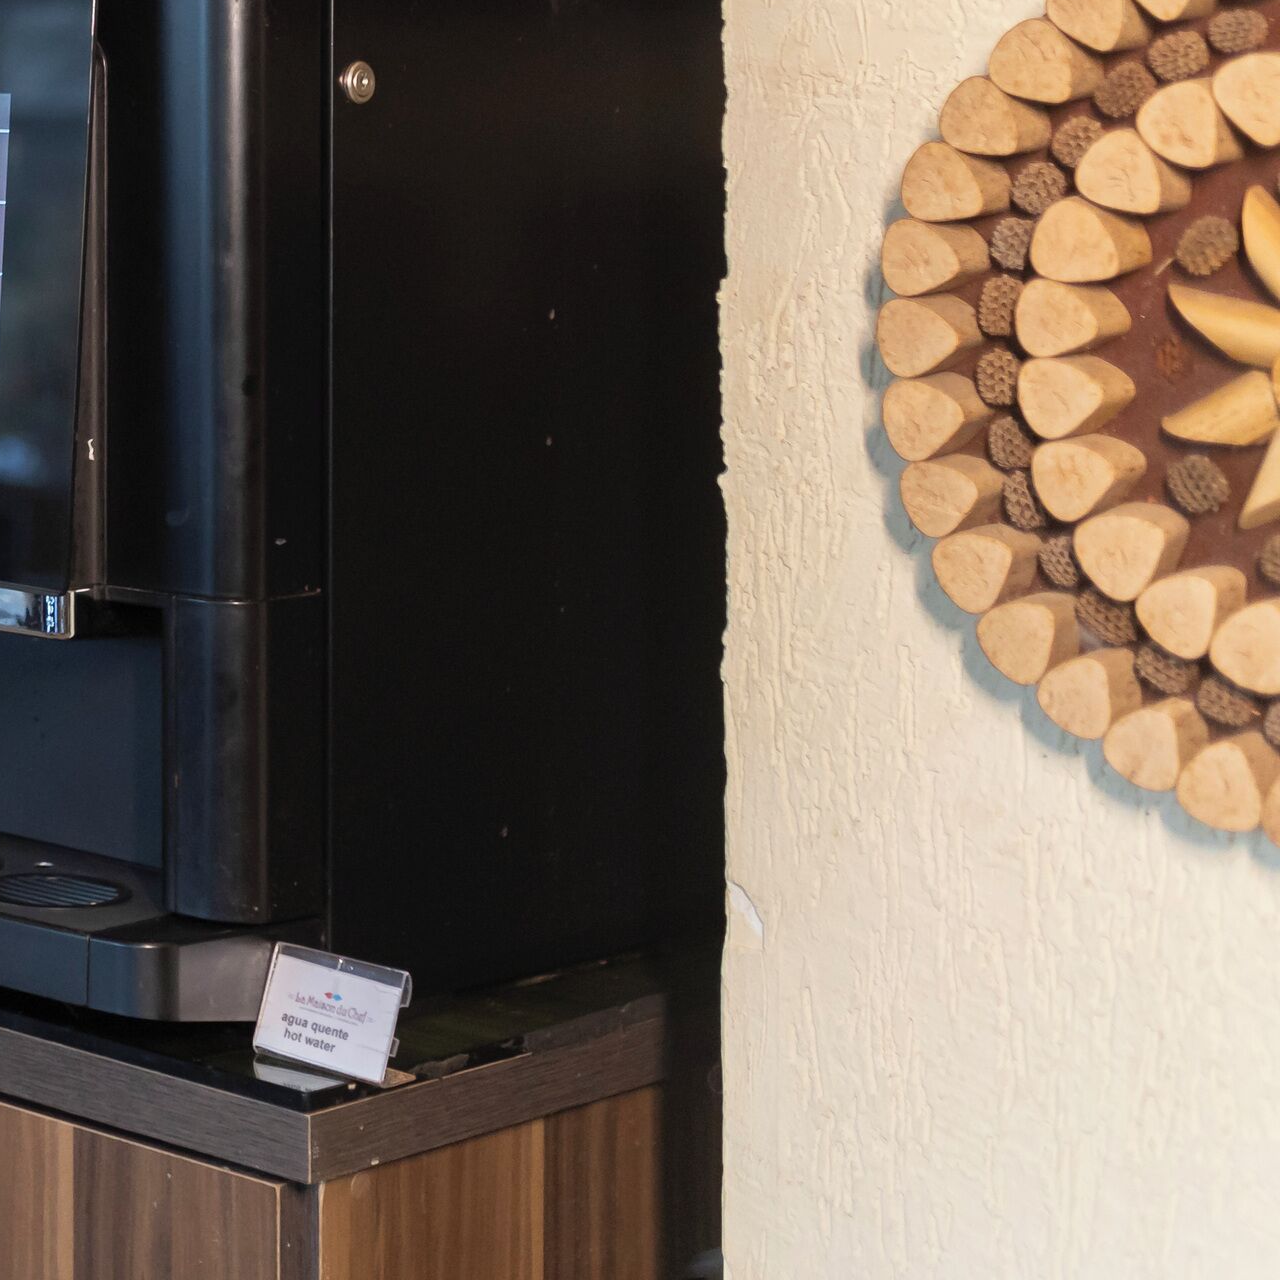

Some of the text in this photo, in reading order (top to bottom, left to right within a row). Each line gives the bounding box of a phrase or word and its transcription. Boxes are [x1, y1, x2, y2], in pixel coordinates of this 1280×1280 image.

[281, 1013, 308, 1027] agua
[311, 1021, 349, 1041] quente
[283, 1028, 336, 1053] hot water
